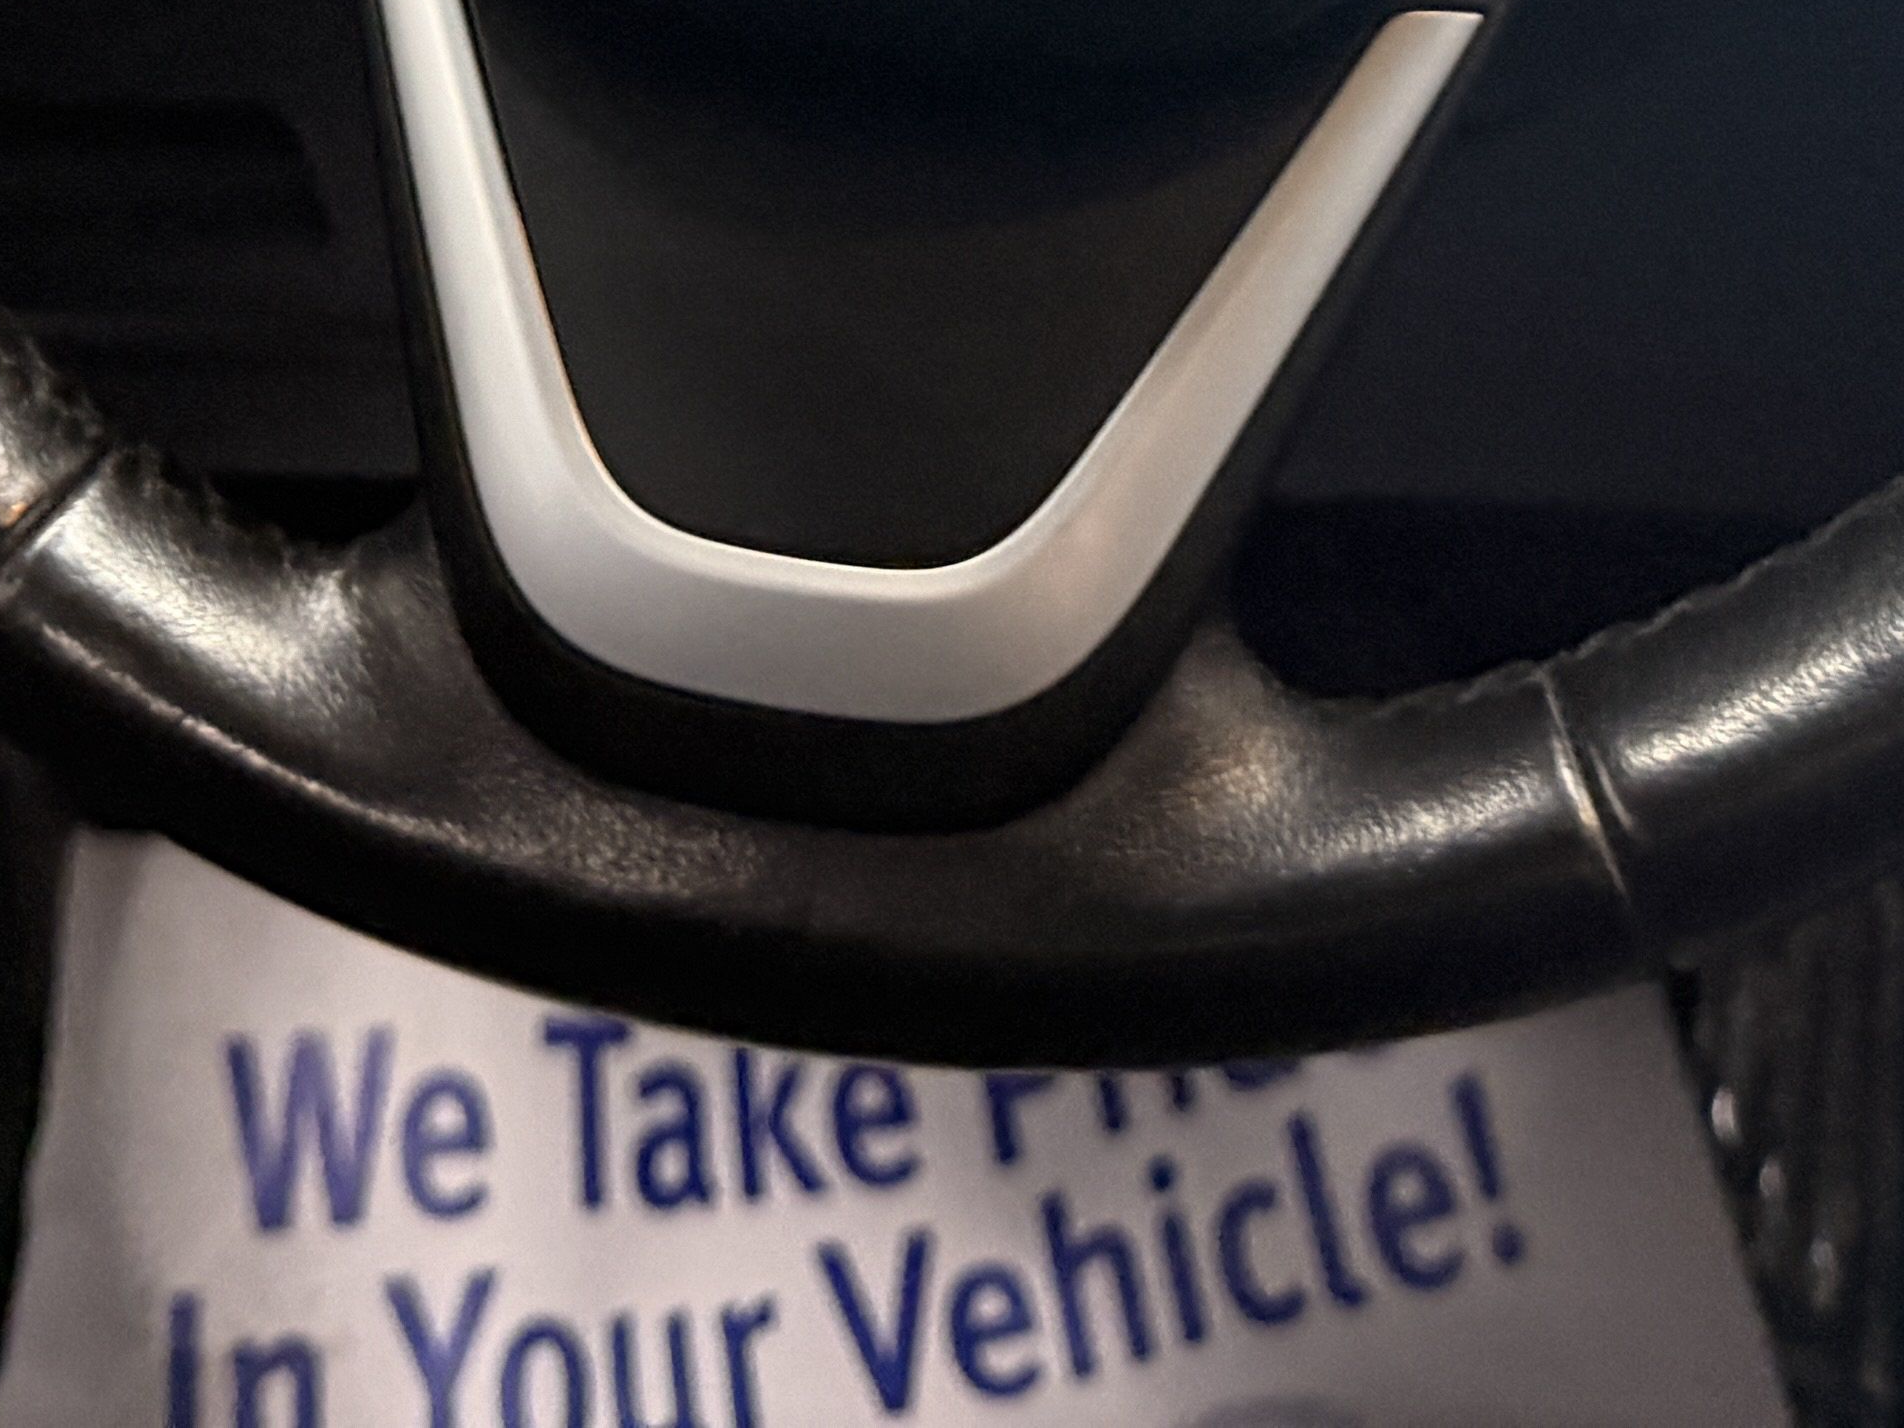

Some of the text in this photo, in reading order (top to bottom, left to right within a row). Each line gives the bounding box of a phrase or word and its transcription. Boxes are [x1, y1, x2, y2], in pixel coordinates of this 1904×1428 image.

[166, 1289, 324, 1428] In
[383, 1263, 778, 1428] Your
[817, 1068, 1526, 1415] Vehicle!
[224, 1020, 493, 1234] We
[540, 1015, 923, 1213] Take
